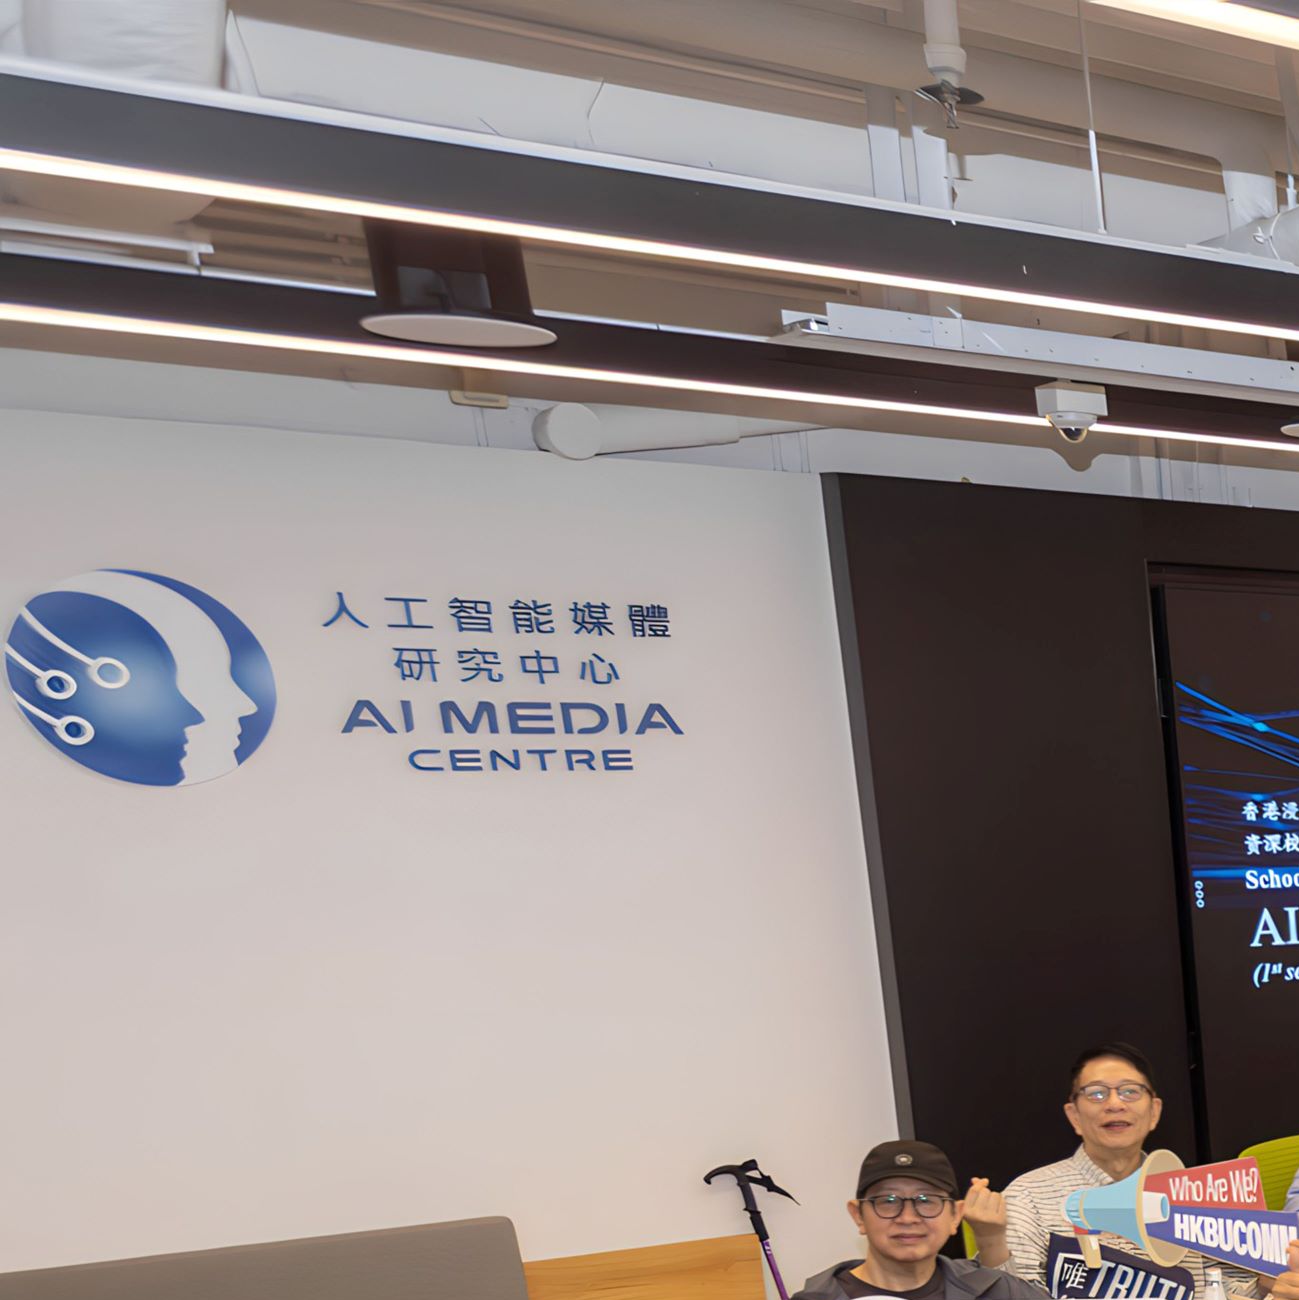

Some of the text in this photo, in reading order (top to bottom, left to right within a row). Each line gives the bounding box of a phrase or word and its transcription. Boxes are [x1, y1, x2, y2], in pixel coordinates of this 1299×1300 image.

[322, 592, 672, 638] 人工智能媒體
[393, 647, 620, 684] 研究中心
[341, 700, 684, 735] AI MEDIA
[407, 749, 634, 771] CENTRE
[1169, 1176, 1203, 1202] Who
[1207, 1173, 1229, 1201] Are
[1174, 1213, 1298, 1266] HKBUCOMM
